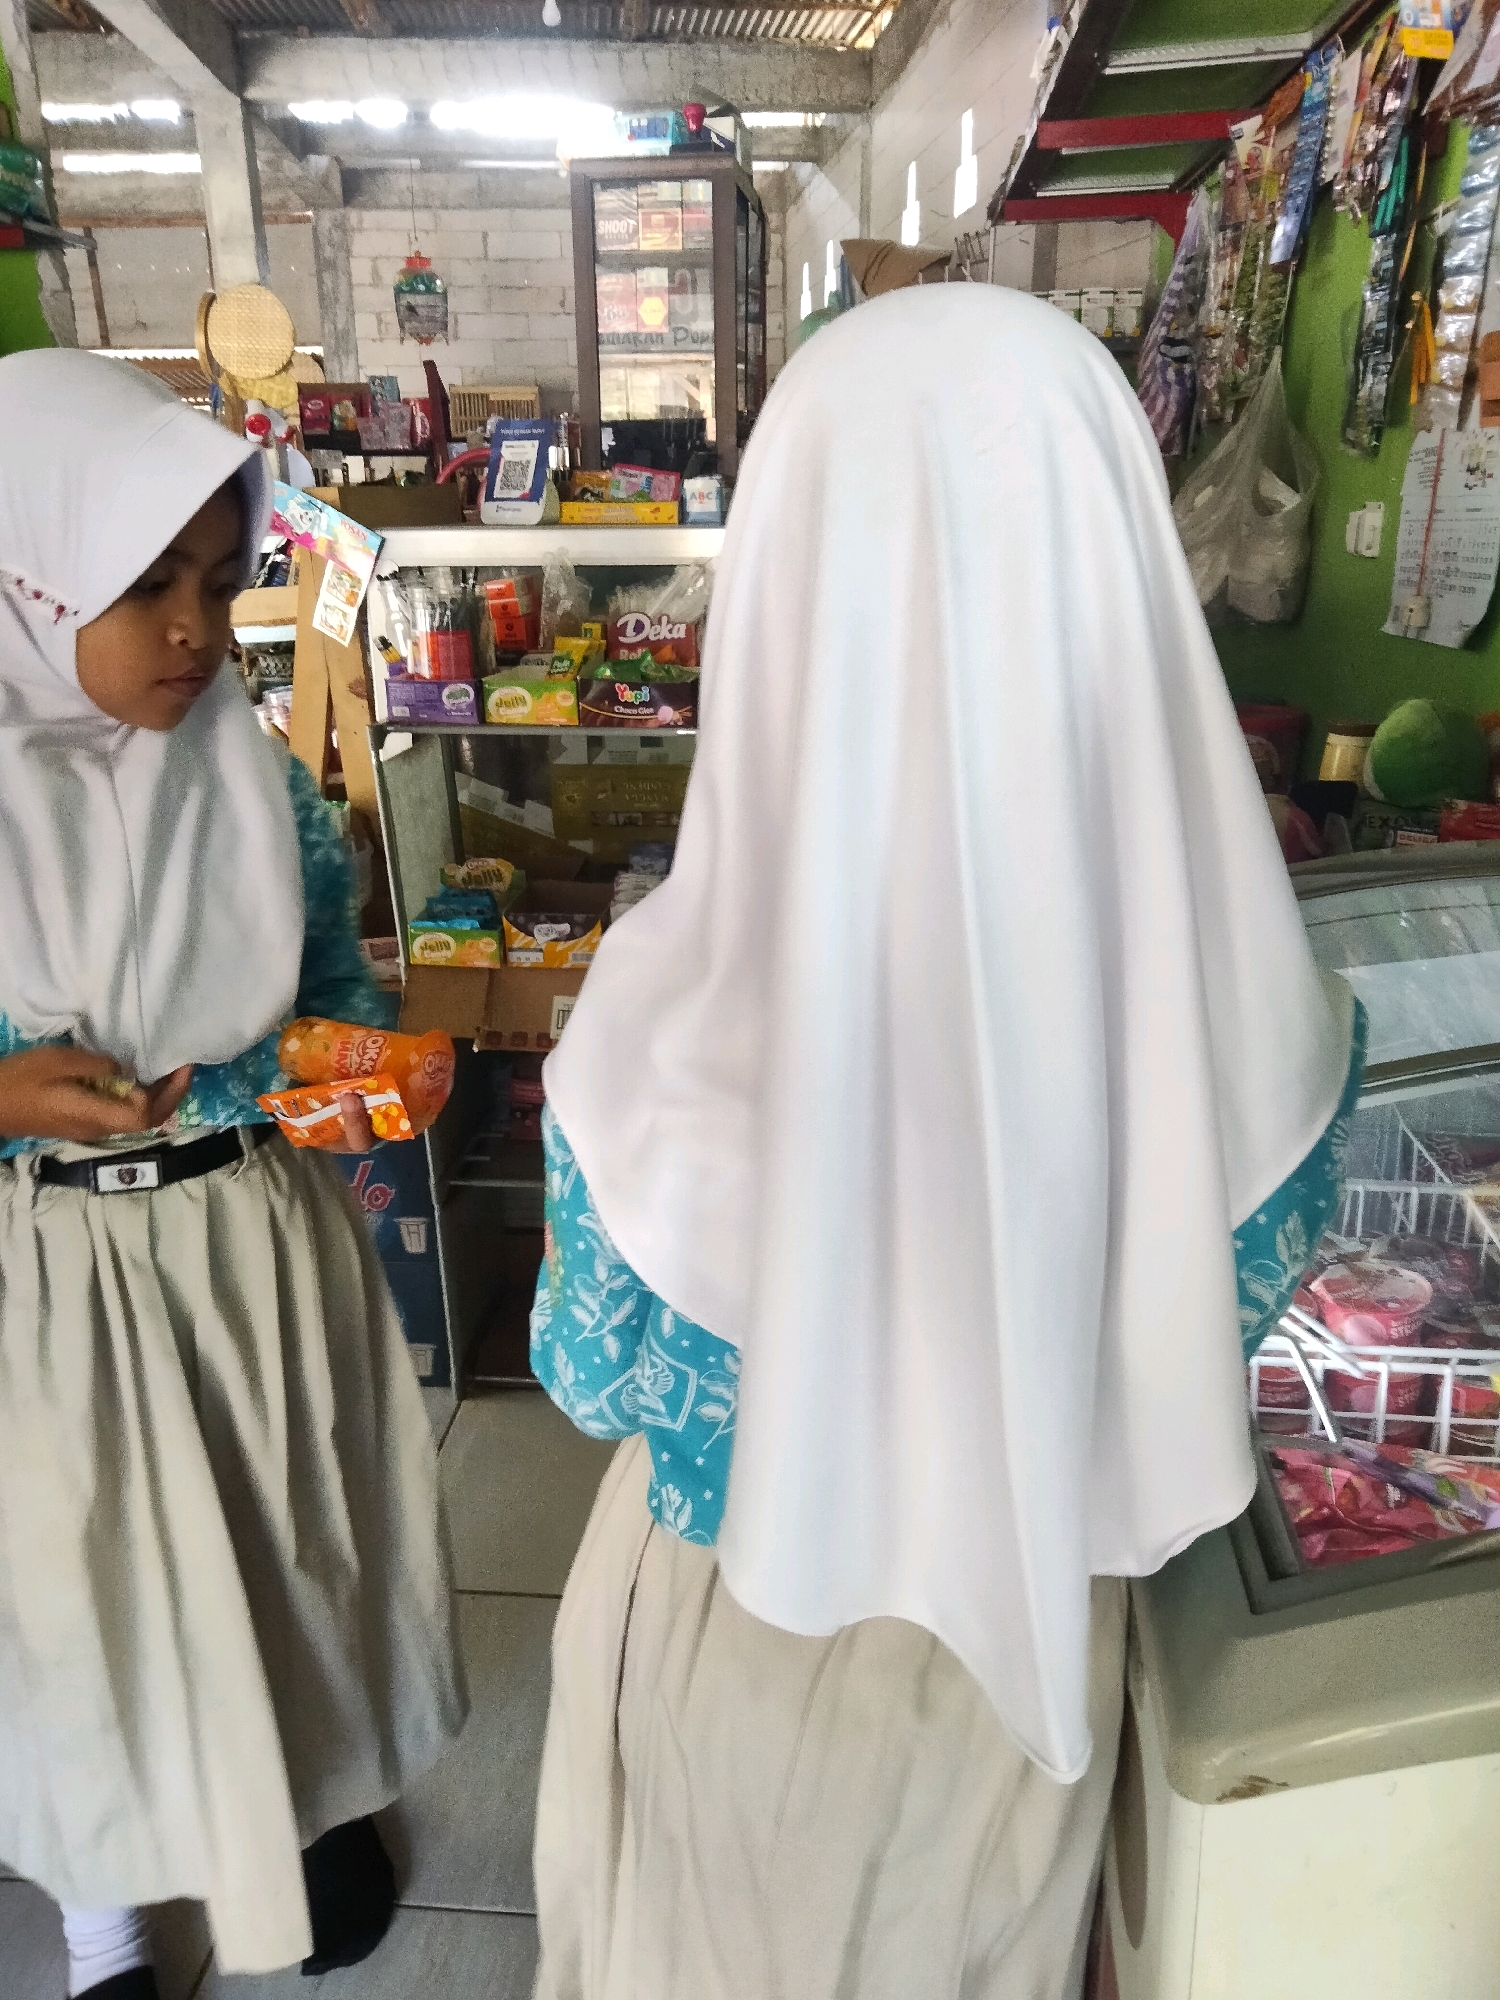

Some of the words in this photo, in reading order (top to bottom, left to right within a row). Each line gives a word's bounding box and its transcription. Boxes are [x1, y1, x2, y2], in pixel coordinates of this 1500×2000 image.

[597, 219, 634, 234] SHOOT
[690, 491, 713, 501] ABC
[617, 612, 687, 644] Deka
[614, 682, 650, 705] Yupi
